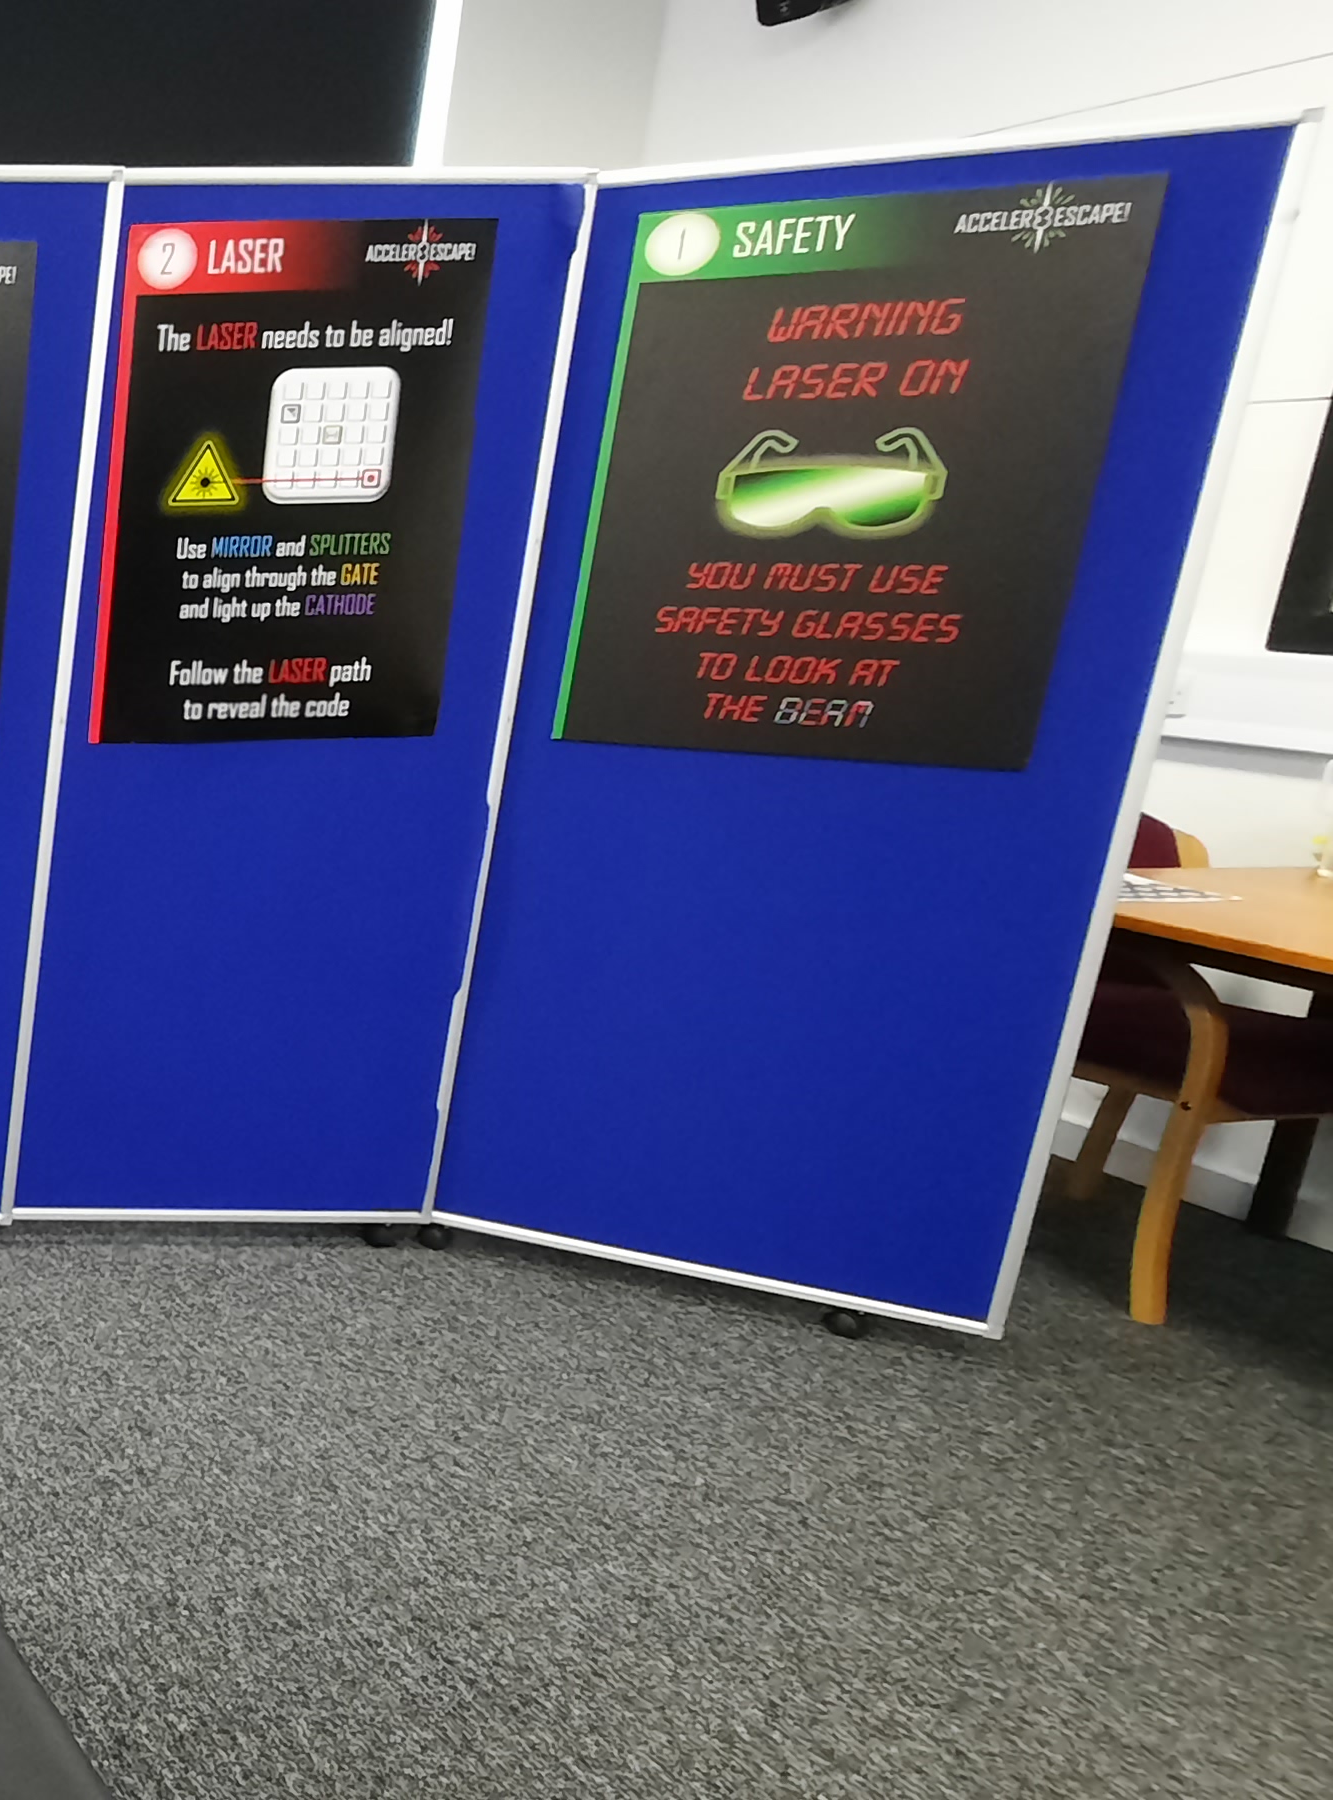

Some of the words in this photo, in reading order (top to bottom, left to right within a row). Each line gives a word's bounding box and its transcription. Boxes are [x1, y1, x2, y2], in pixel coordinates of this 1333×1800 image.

[733, 212, 856, 259] SAFETY
[160, 242, 175, 275] 2
[207, 238, 284, 274] LASER
[157, 324, 191, 351] The
[197, 321, 258, 350] LASER
[261, 321, 319, 350] needs
[325, 325, 345, 347] to
[349, 320, 373, 347] be
[378, 318, 454, 352] aligned!
[766, 298, 966, 342] WARNING
[743, 361, 887, 401] LASER
[899, 358, 969, 396] ON
[176, 537, 206, 559] Use
[211, 535, 273, 558] MIRROR
[275, 535, 306, 557] and
[309, 533, 391, 556] SPLITTERS
[182, 571, 198, 589] to
[203, 567, 240, 593] align
[245, 565, 306, 591] through
[311, 564, 336, 586] the
[340, 563, 380, 586] GATE
[686, 561, 753, 591] YOU
[764, 562, 862, 593] MUST
[869, 563, 948, 594] USE
[654, 606, 785, 635] SAFETY
[791, 609, 962, 644] GLASSES
[169, 660, 228, 686] Follow
[234, 659, 263, 684] the
[268, 657, 327, 683] LASER
[329, 656, 372, 687] path
[703, 692, 767, 722] THE
[773, 697, 873, 728] BEAM
